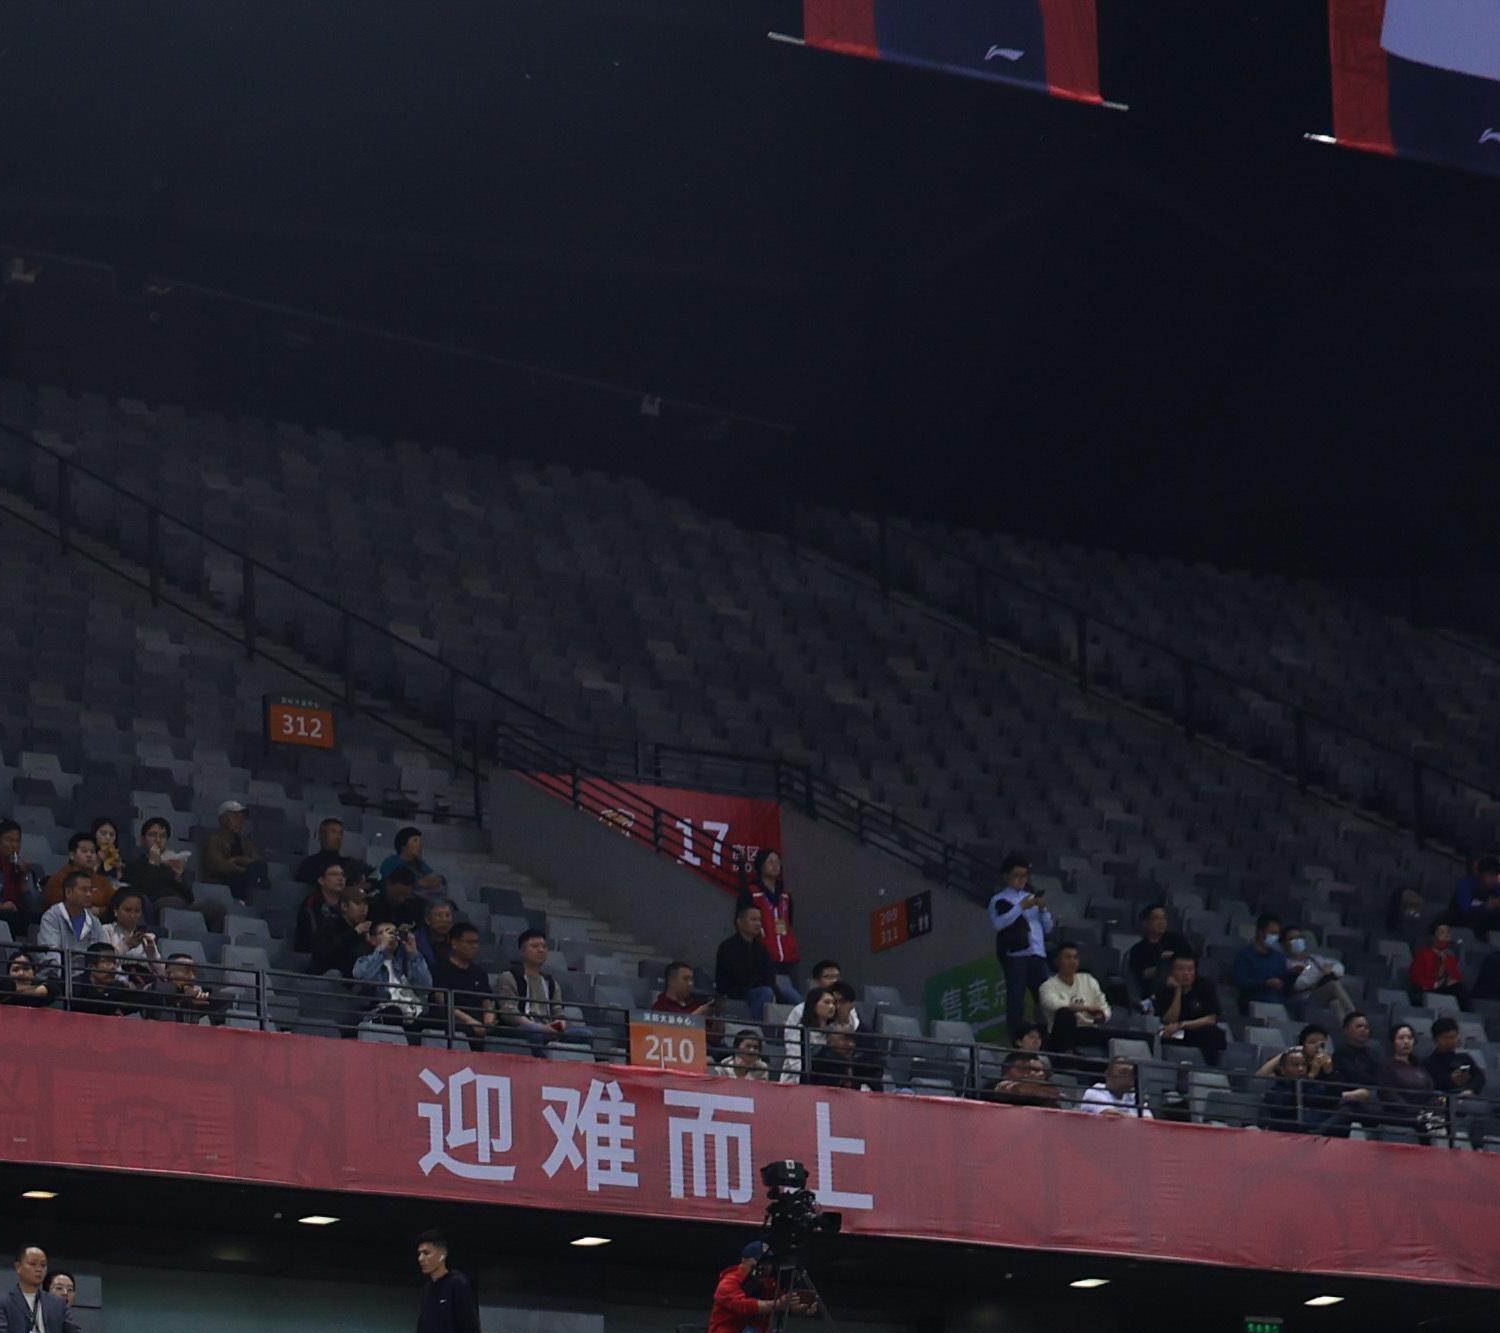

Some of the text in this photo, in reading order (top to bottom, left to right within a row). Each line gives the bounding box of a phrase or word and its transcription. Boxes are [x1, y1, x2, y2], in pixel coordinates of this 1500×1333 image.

[282, 714, 322, 738] 312
[676, 819, 729, 867] 17
[645, 1035, 695, 1064] 210
[417, 1066, 874, 1211] 迎难而上
